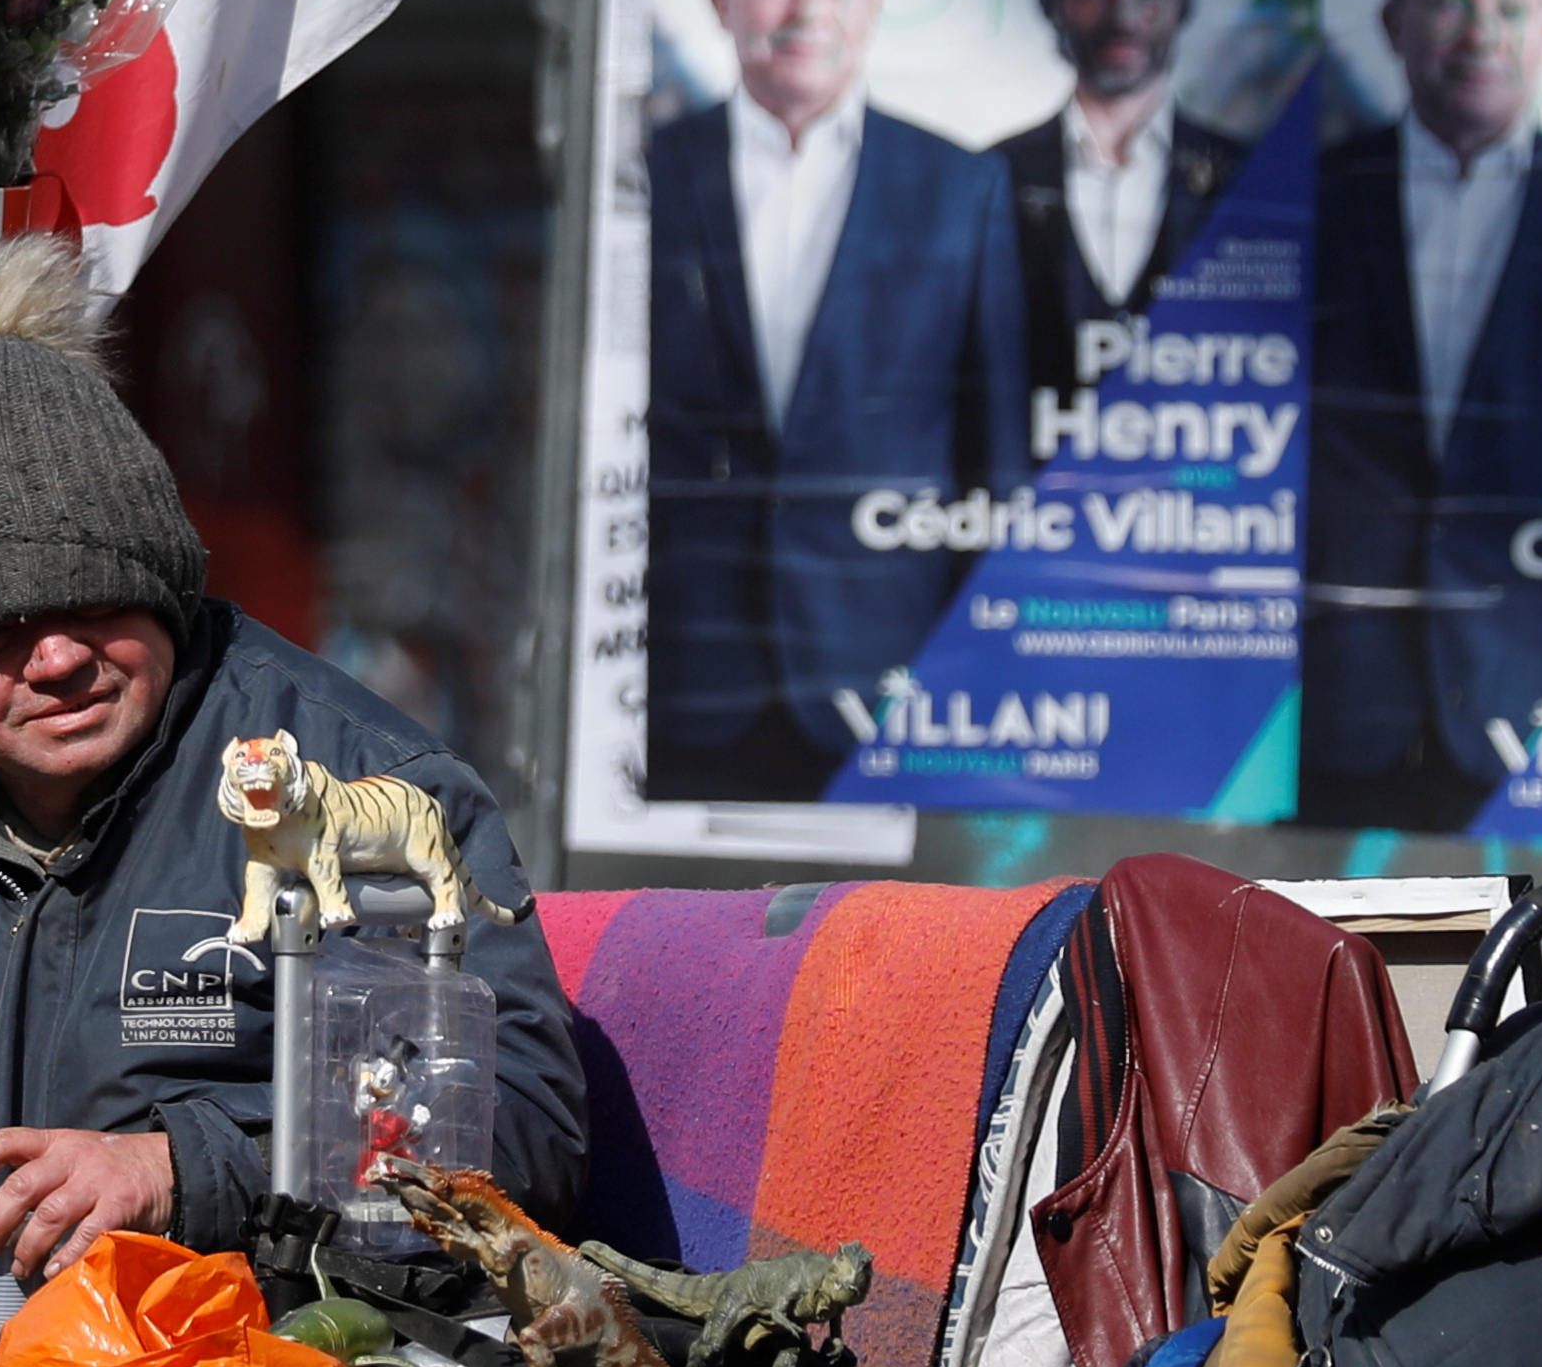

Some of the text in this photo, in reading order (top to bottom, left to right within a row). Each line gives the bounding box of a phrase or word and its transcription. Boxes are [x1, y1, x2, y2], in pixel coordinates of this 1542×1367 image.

[1075, 318, 1297, 386] Pierre
[1031, 387, 1300, 478] Henry
[851, 484, 1297, 555] Cédric Villani
[131, 969, 223, 992] CNP
[126, 995, 224, 1007] ASSURANCES
[121, 1017, 236, 1029] TECHNOLOGIES DE
[121, 1030, 236, 1042] L'INFORMATION
